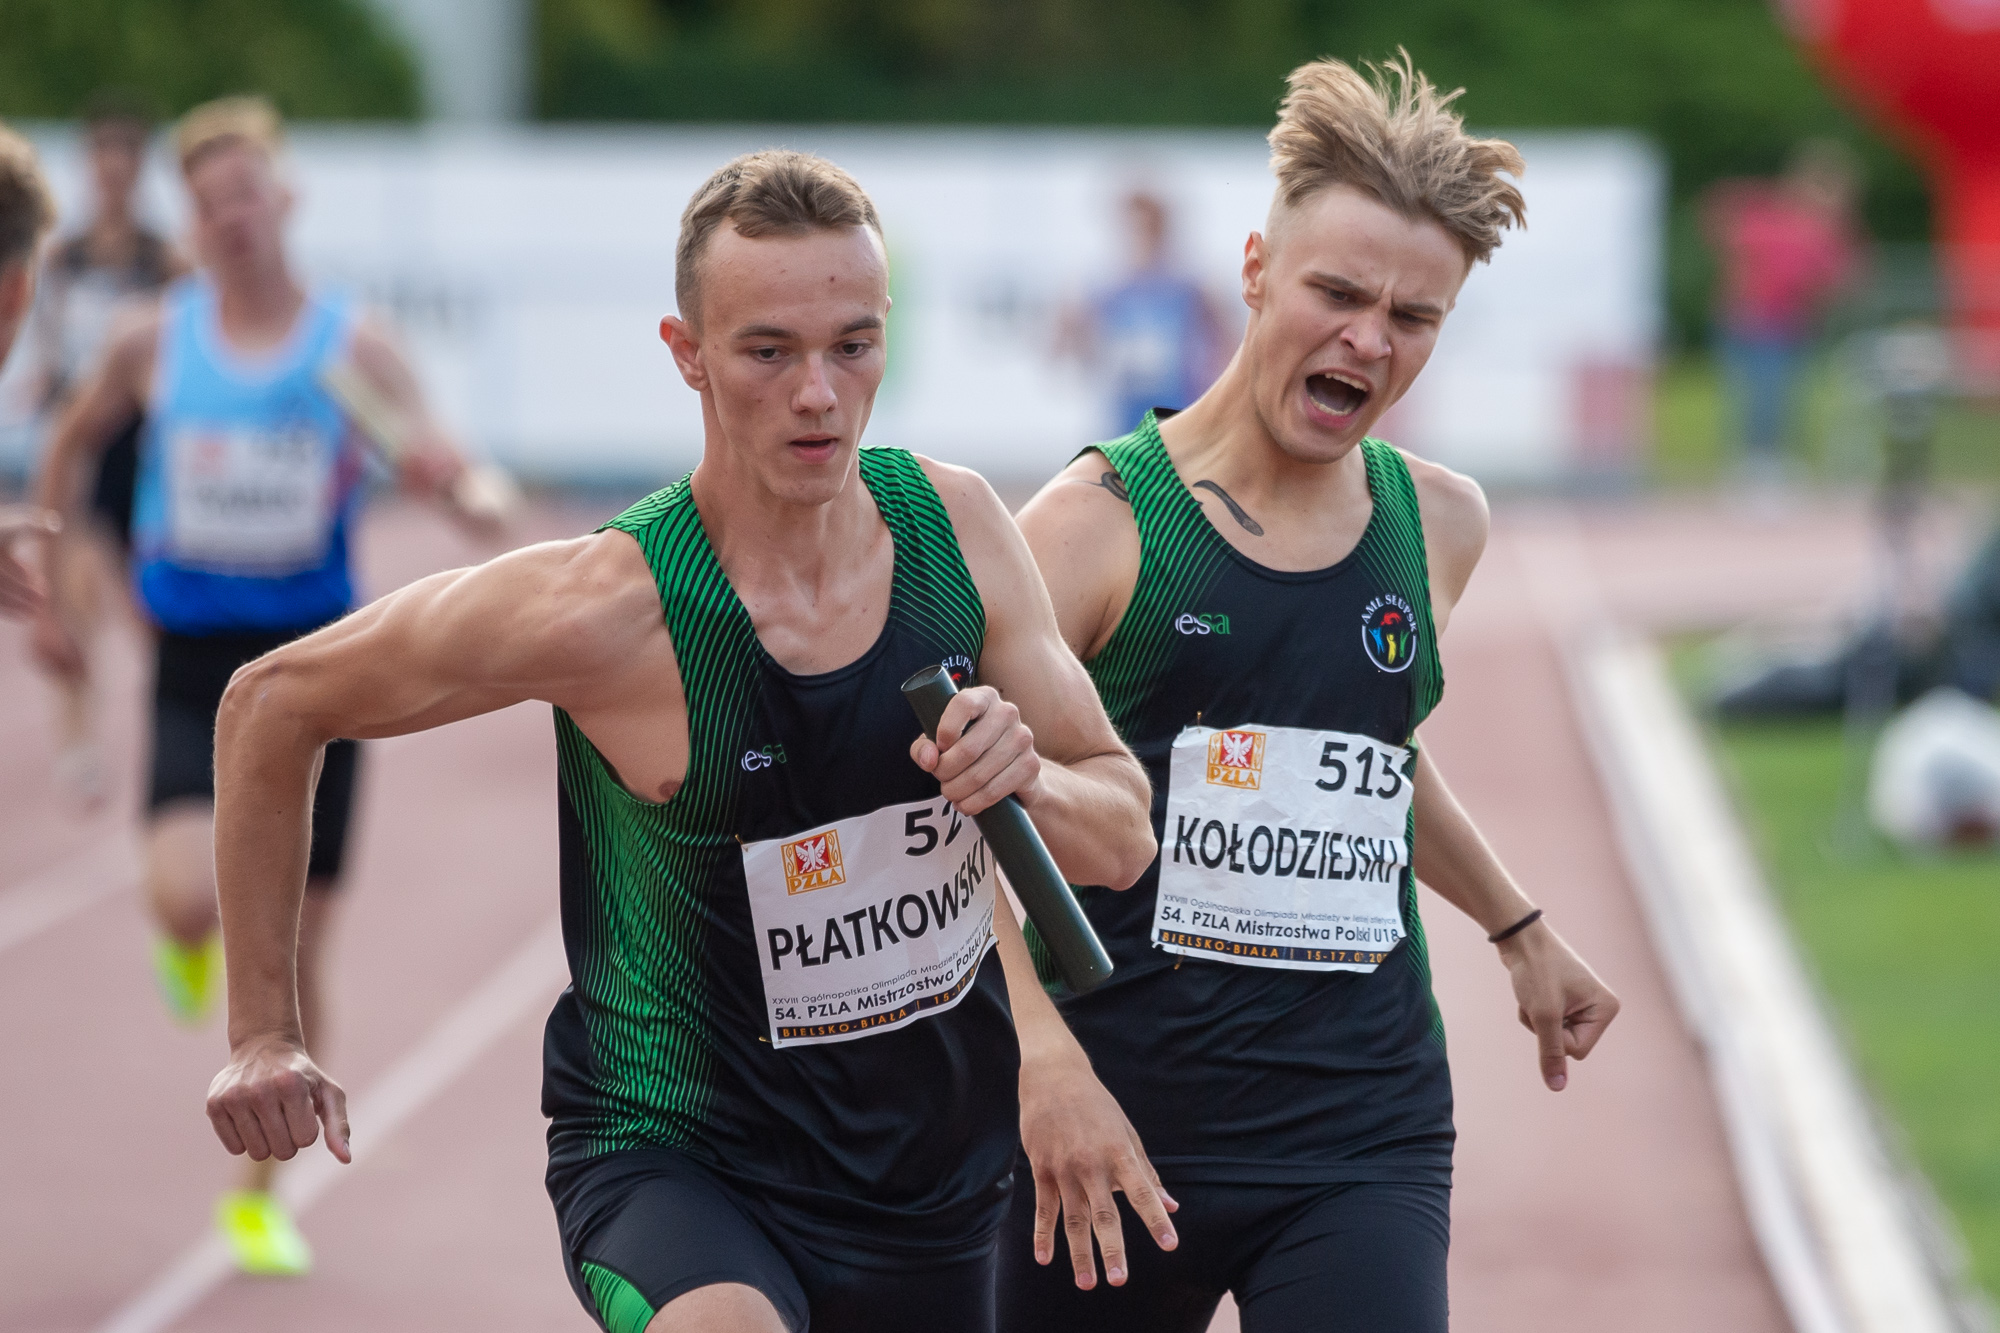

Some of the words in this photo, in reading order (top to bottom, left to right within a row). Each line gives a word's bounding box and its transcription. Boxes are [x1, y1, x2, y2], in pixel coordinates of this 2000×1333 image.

[1175, 613, 1231, 635] esa
[1210, 767, 1257, 786] PZLA
[905, 801, 969, 856] 52
[1173, 815, 1398, 883] KOŁODZIEJSKI
[790, 868, 842, 892] PZLA
[767, 836, 986, 970] PŁATKOWSKI
[1161, 906, 1185, 923] 54.
[1192, 911, 1230, 932] PZLA
[1235, 919, 1330, 940] Mistrzostwa
[1335, 926, 1371, 942] Polski
[1374, 928, 1400, 943] U18
[1162, 931, 1279, 958] BIELSKO-BIAŁA
[775, 1007, 802, 1020] 54.
[807, 1001, 851, 1018] PZLA
[857, 969, 954, 1010] Mistrzostwa
[956, 936, 981, 972] Polski
[801, 986, 869, 1004] Ogólnopolska
[871, 968, 917, 990] Olimpiada
[782, 1008, 907, 1037] BIELSKO-BIAŁA
